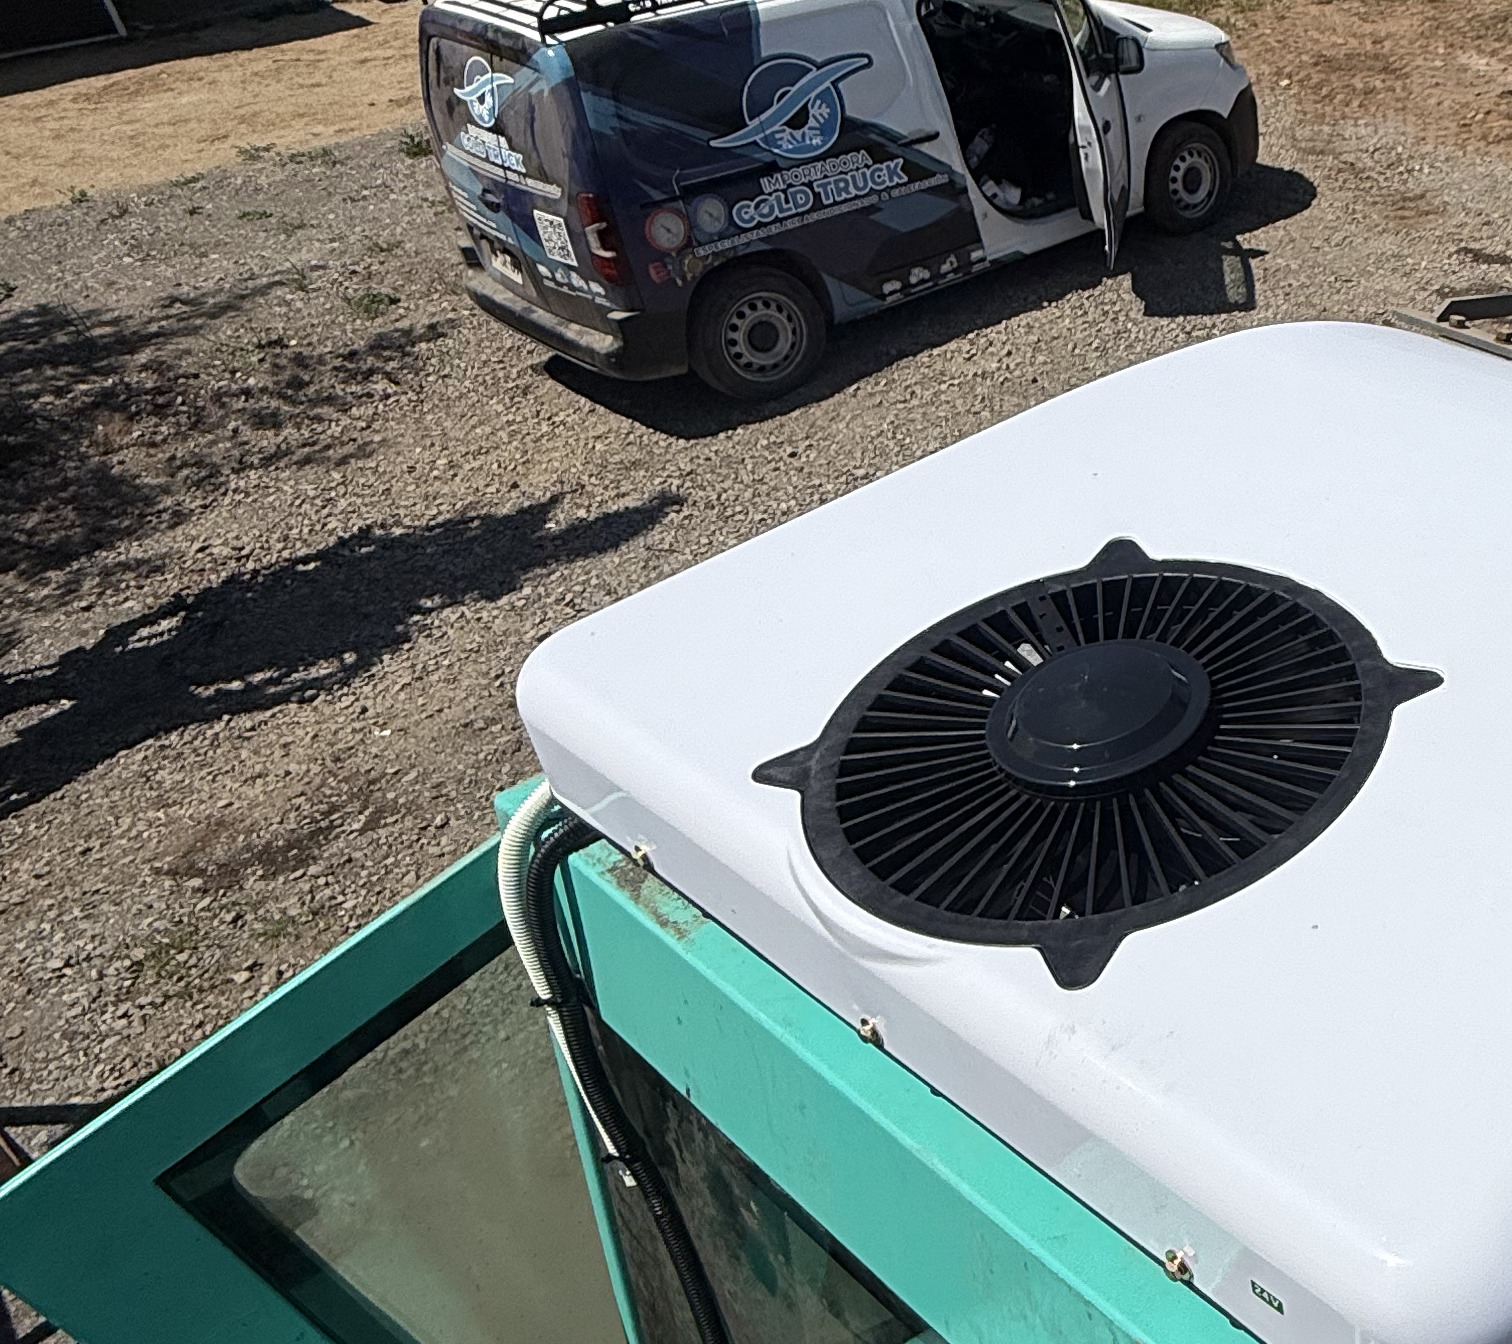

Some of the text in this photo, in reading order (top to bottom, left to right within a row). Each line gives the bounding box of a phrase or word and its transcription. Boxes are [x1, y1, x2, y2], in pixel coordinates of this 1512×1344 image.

[732, 158, 908, 228] COLD TRUCK
[760, 150, 873, 194] IMPORTADORA
[1253, 1284, 1280, 1308] 24V
